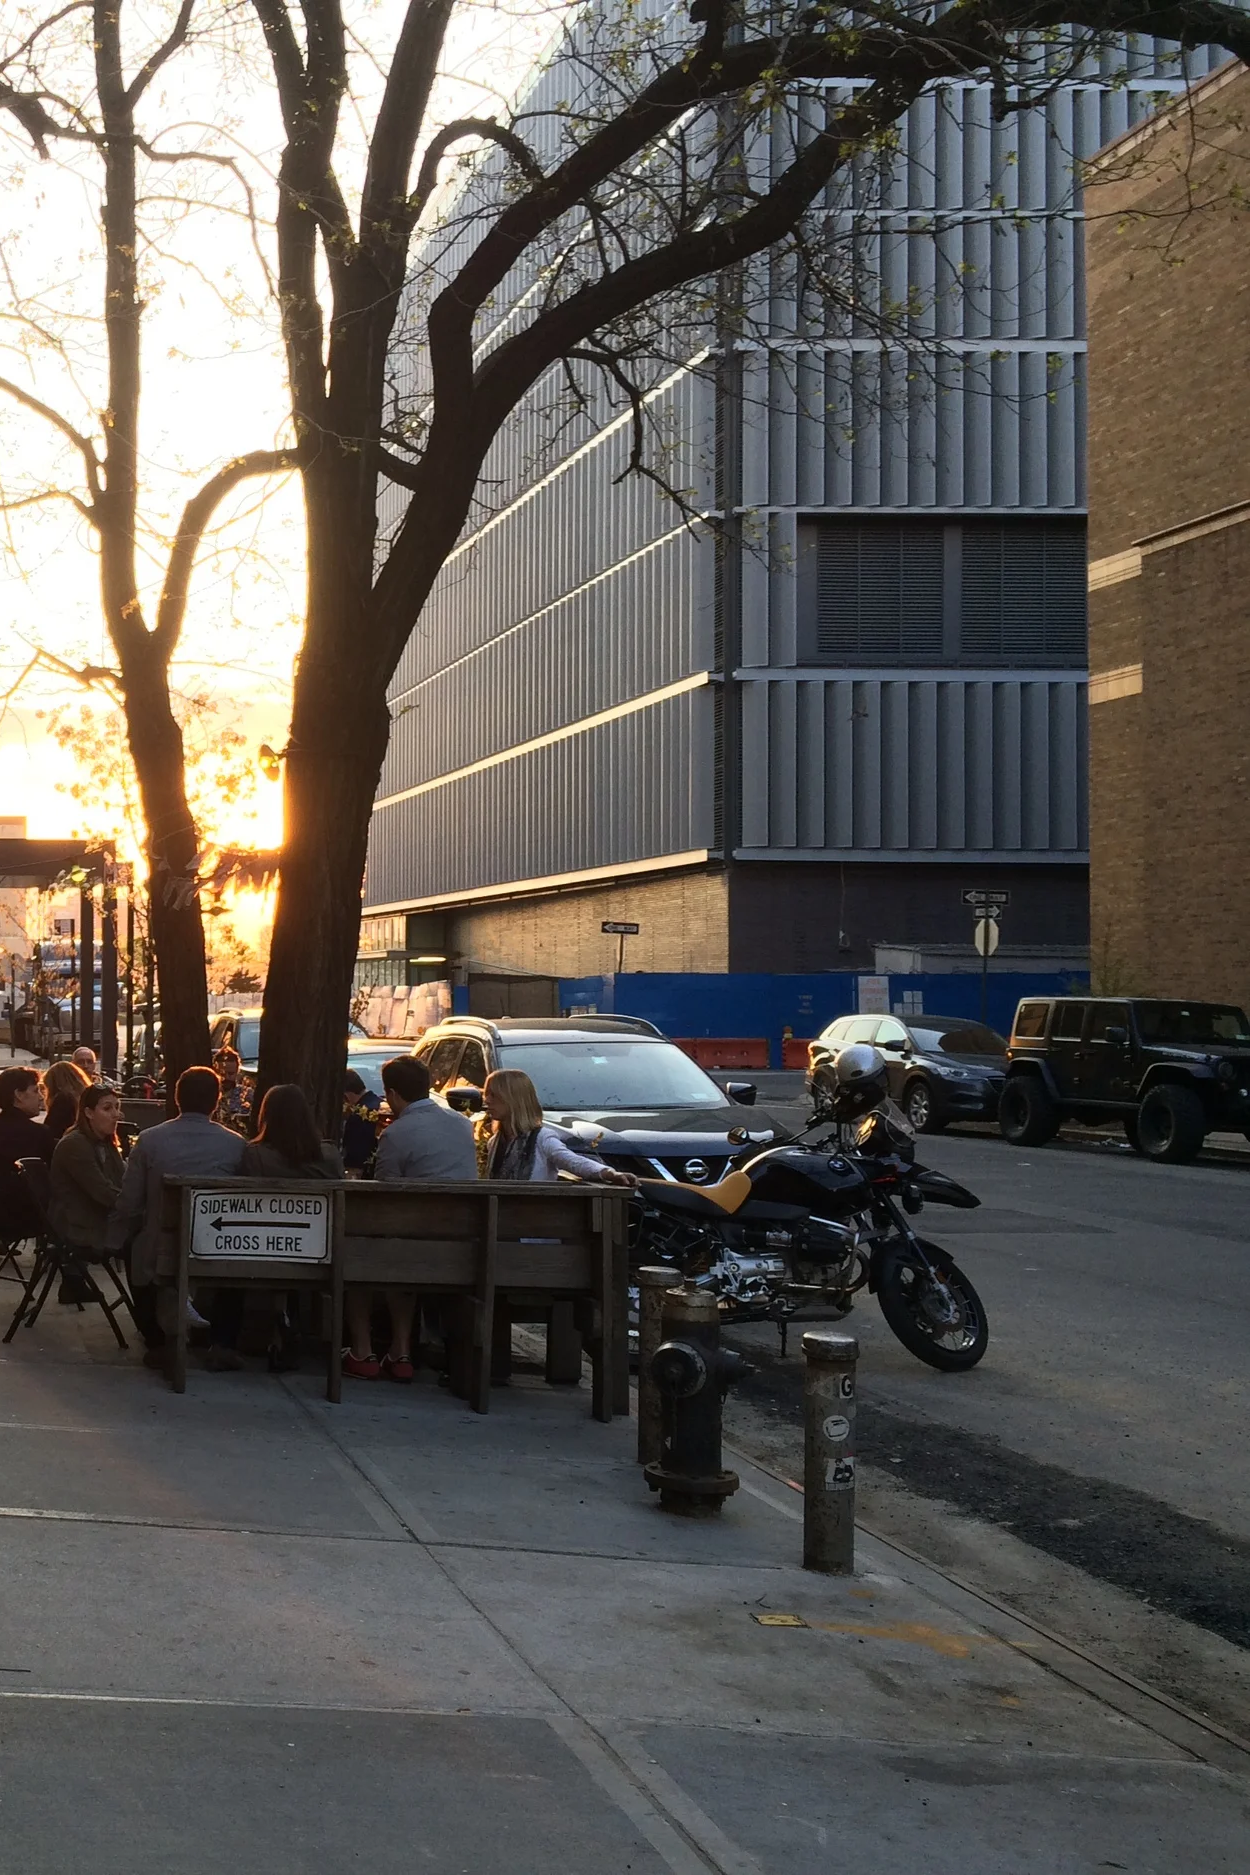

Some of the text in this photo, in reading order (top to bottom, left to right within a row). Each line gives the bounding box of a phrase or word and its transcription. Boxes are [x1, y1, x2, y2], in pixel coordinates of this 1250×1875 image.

[200, 1198, 323, 1216] SIDEWALK CLOSED
[215, 1235, 303, 1253] CROSS HERE
